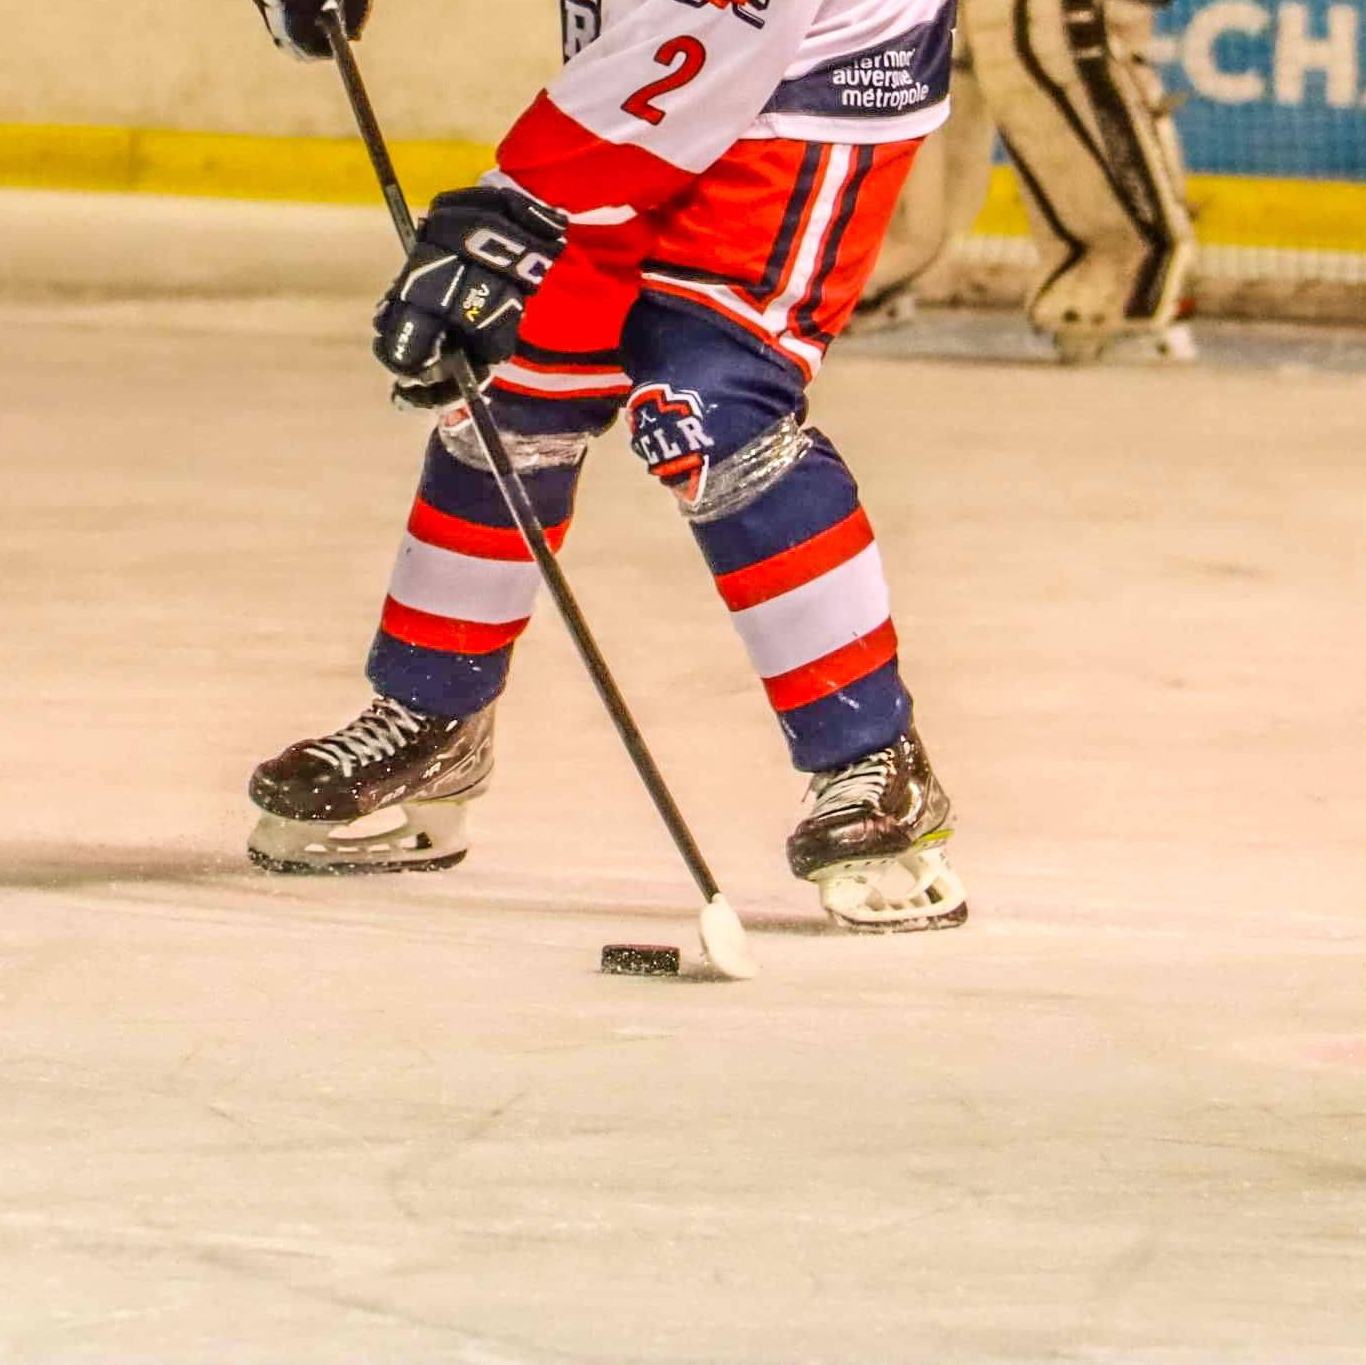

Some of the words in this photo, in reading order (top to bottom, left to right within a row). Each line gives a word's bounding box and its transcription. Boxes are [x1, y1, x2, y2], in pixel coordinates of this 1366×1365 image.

[620, 34, 707, 126] 2
[841, 81, 930, 111] métropole
[463, 226, 555, 286] CC
[636, 416, 716, 466] CLR
